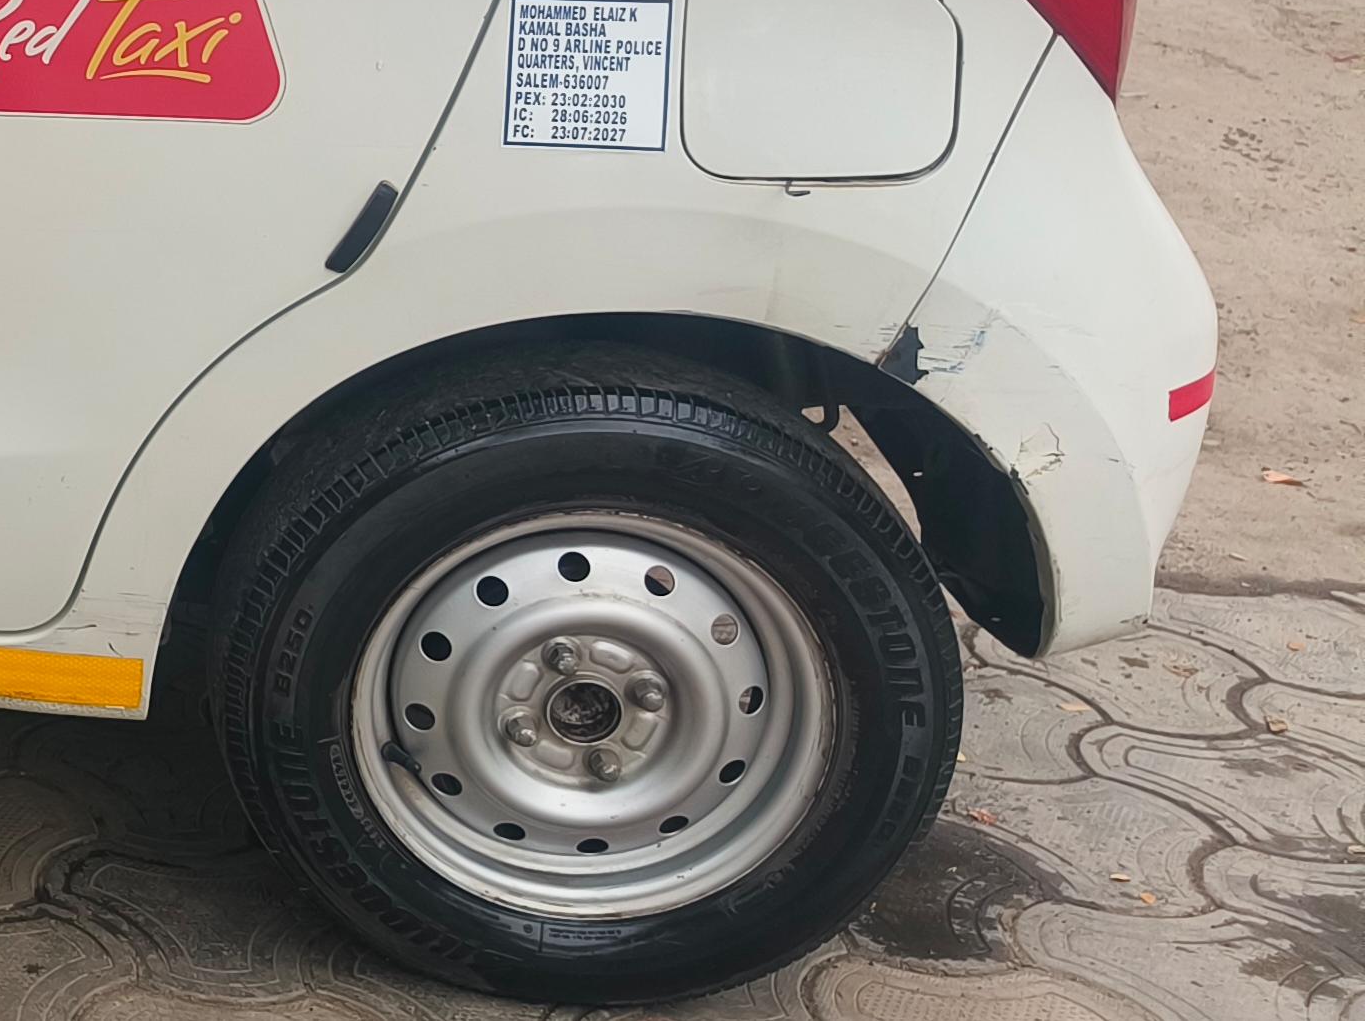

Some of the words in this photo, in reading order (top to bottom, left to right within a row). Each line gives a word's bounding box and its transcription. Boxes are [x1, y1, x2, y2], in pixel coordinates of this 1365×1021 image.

[519, 4, 587, 21] MOHAMMED
[593, 7, 626, 22] ELAIZ
[629, 7, 638, 22] K
[518, 21, 561, 36] KAMAL
[565, 22, 607, 37] BASHA
[518, 38, 526, 51] D
[530, 38, 548, 52] NO
[553, 38, 560, 52] 9
[564, 39, 612, 54] ARLINE
[616, 40, 662, 55] POLICE
[517, 53, 579, 73] QUARTERS,
[582, 55, 631, 71] VINCENT
[514, 91, 546, 106] PEX:
[550, 92, 626, 108] 23:02:2030
[551, 109, 628, 125] 28:06:2026
[513, 124, 535, 138] FC:
[551, 125, 626, 142] 23:07:2027
